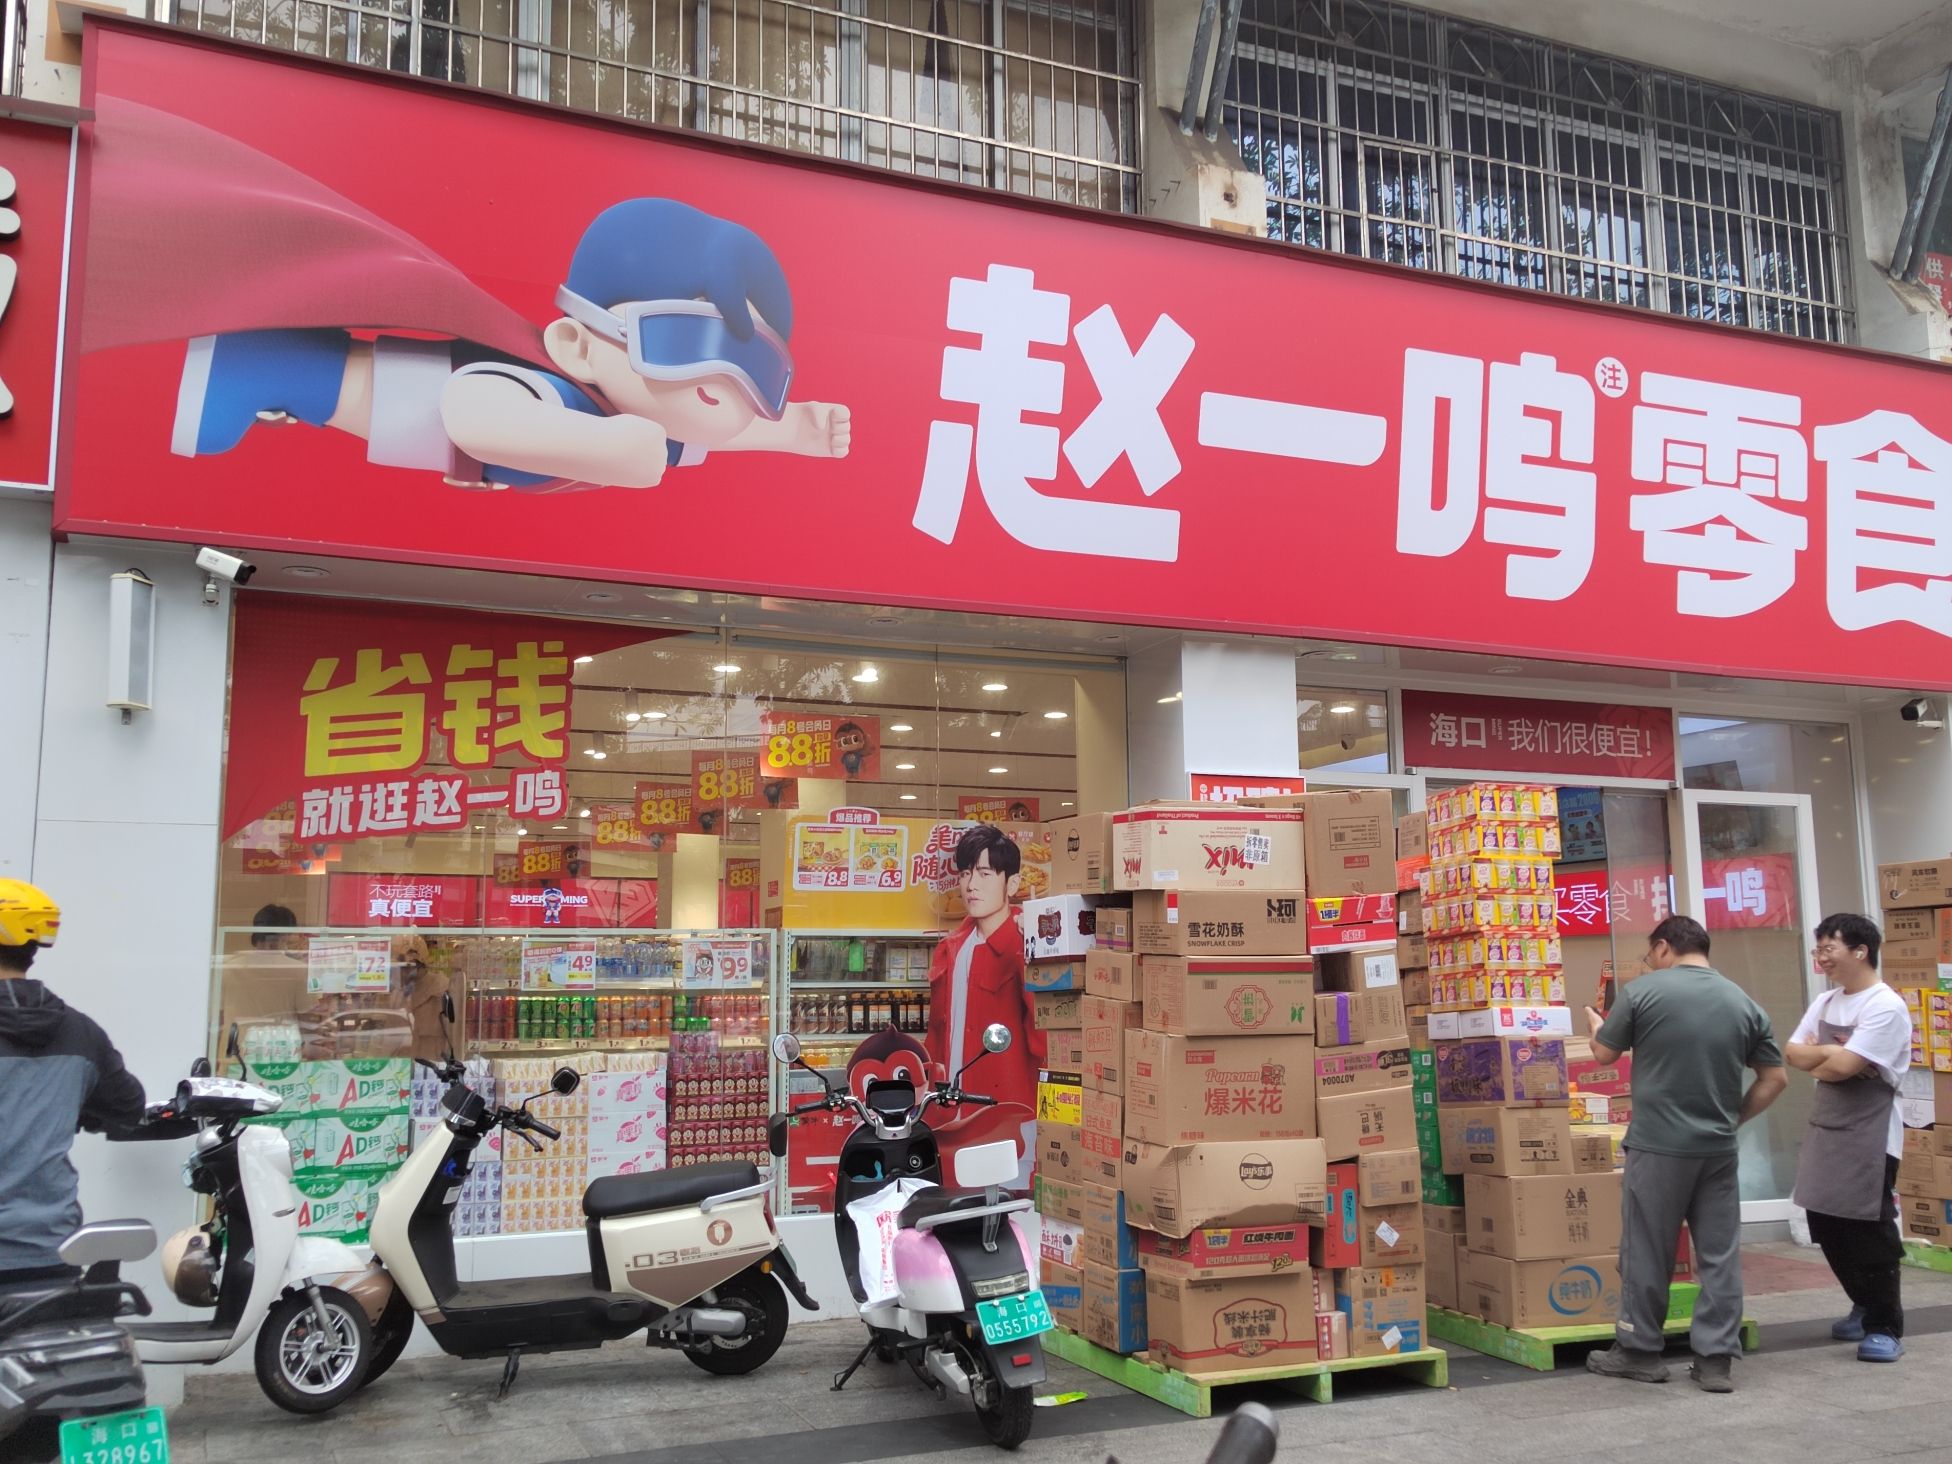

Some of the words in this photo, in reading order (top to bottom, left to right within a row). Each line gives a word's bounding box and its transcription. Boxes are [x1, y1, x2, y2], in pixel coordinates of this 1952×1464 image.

[301, 641, 568, 776] 省钱
[1430, 713, 1487, 749] 海口
[300, 770, 563, 838] 就逛赵一鸣
[368, 884, 434, 899] 不玩套路
[510, 894, 545, 904] SUPER
[560, 895, 588, 904] MING
[368, 898, 433, 918] 真便宜
[1187, 922, 1245, 938] 雪花奶酥
[1187, 940, 1227, 948] SNOWFLAKE
[1227, 940, 1245, 948] CRISP
[1205, 1068, 1260, 1085] Popcorn
[1323, 1073, 1355, 1086] A070004
[1204, 1087, 1283, 1116] 爆米花
[1565, 1187, 1589, 1209] 金典
[985, 1310, 1050, 1339] 0555792
